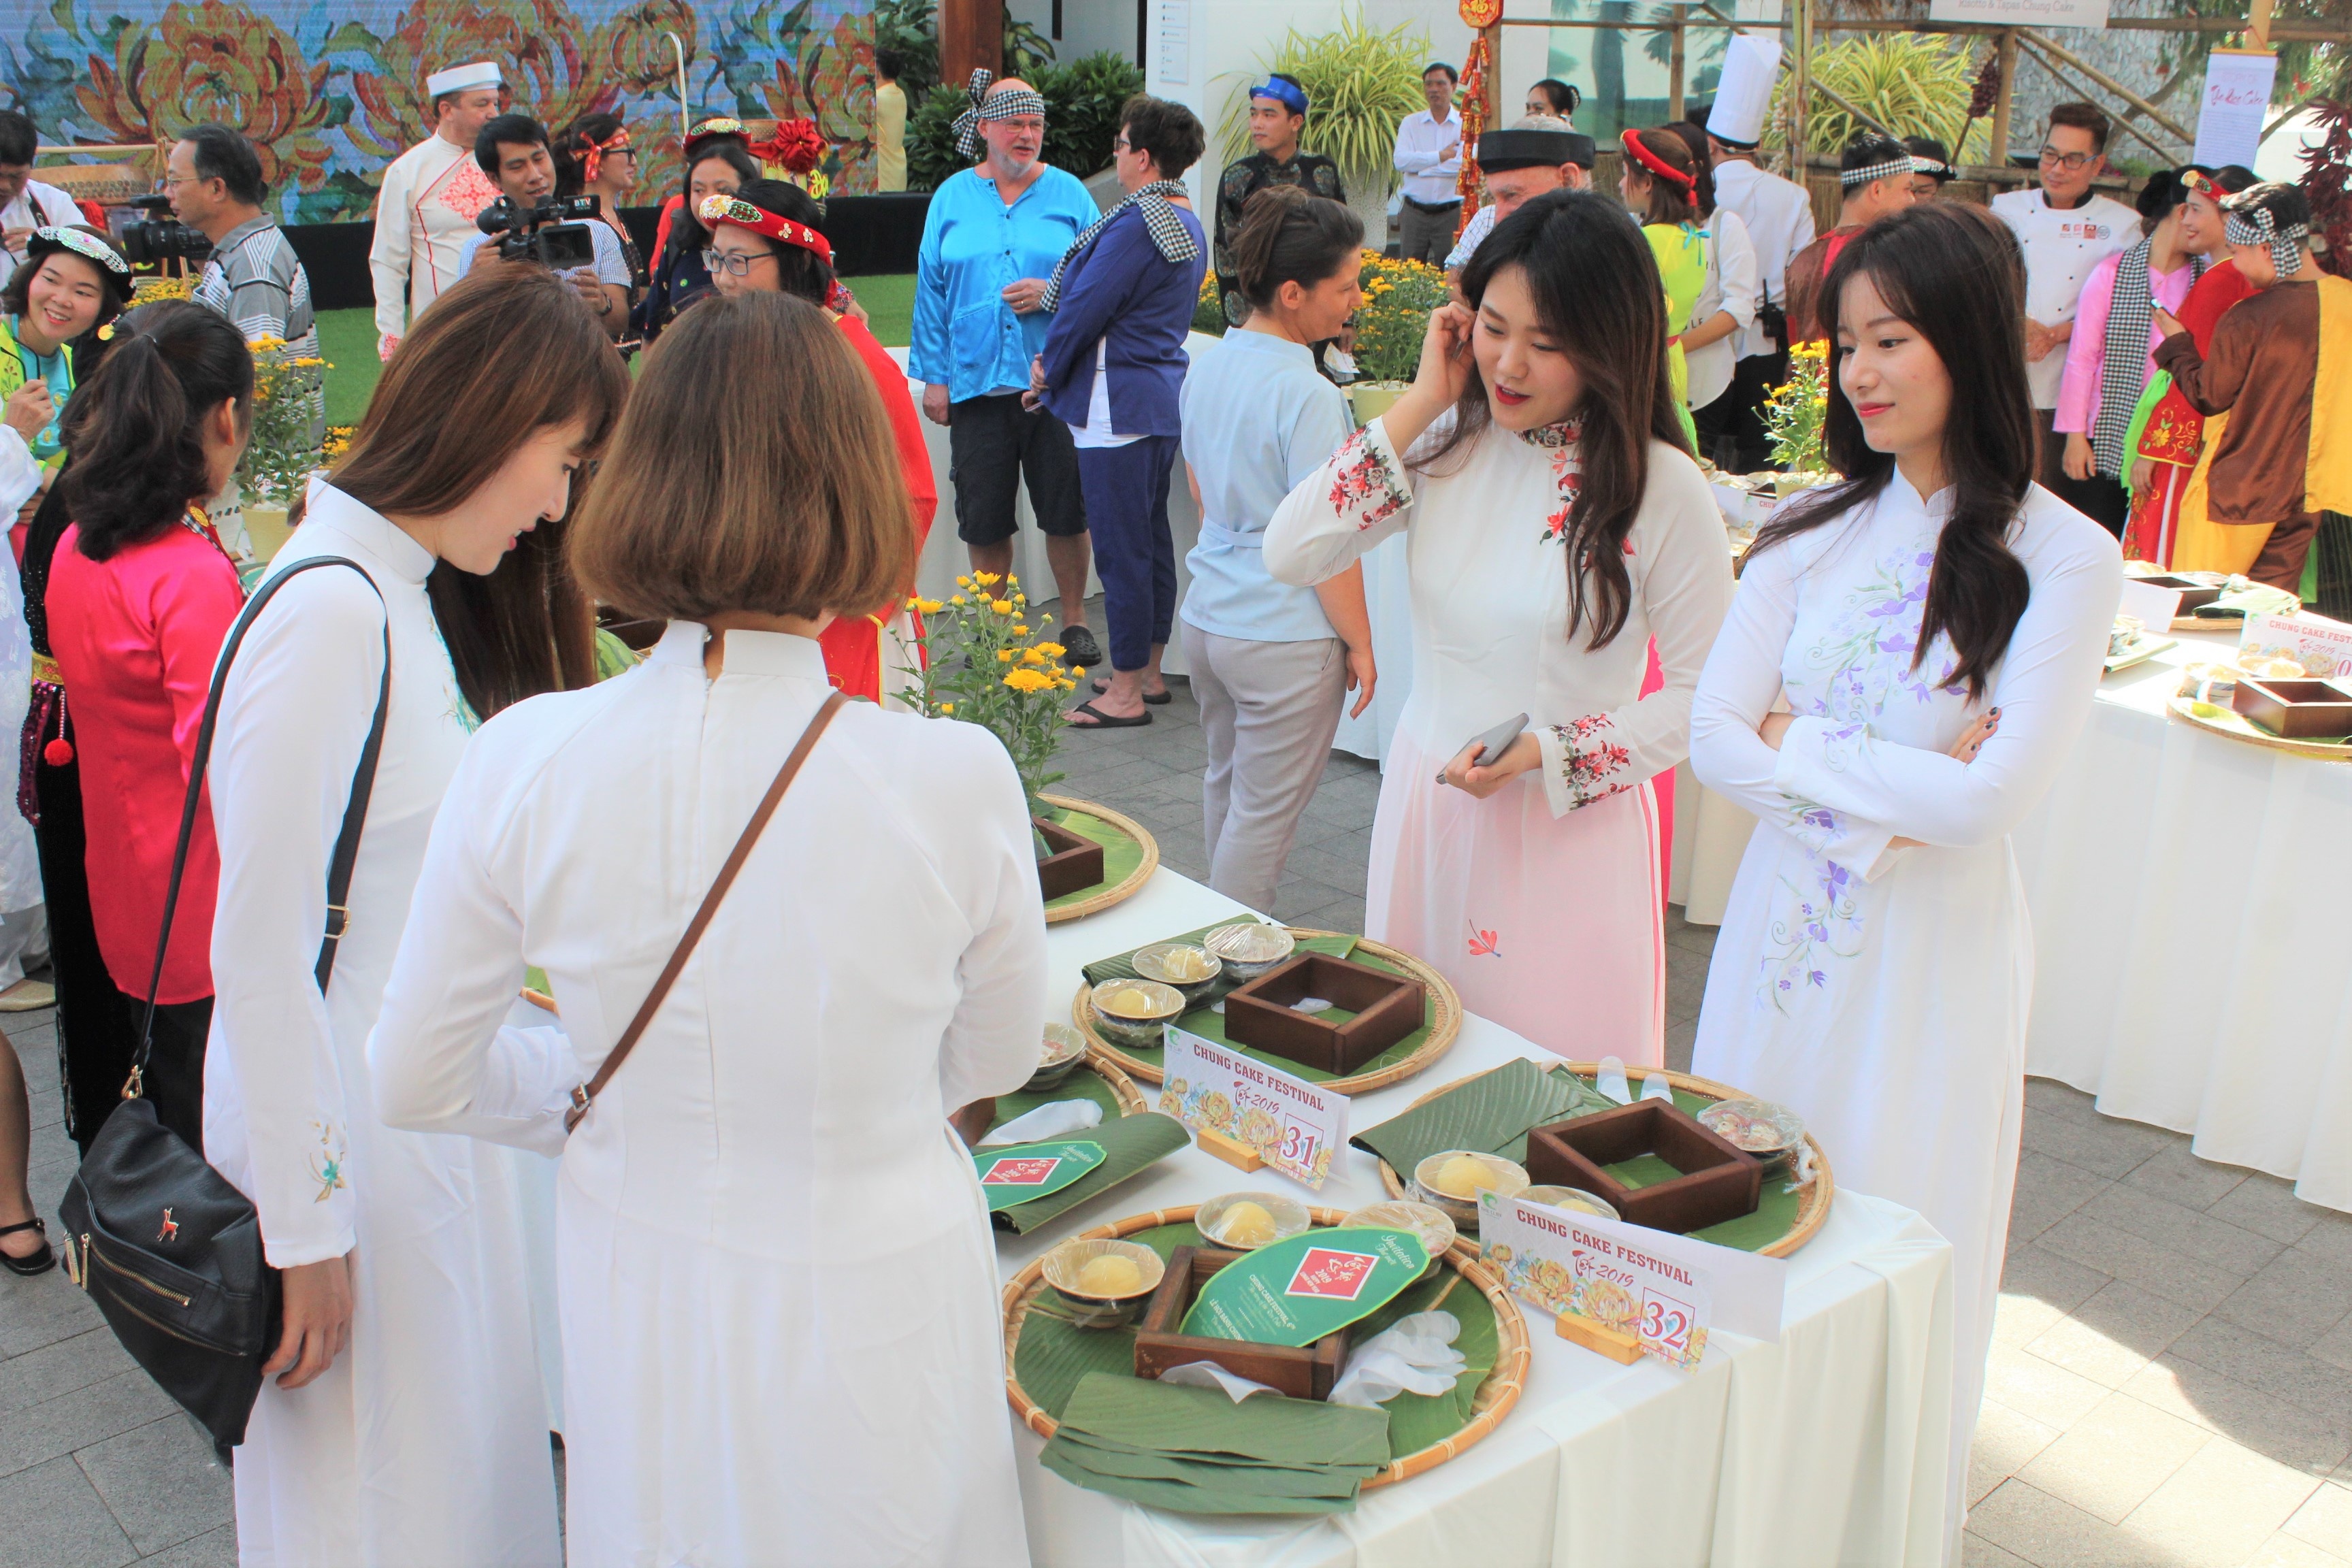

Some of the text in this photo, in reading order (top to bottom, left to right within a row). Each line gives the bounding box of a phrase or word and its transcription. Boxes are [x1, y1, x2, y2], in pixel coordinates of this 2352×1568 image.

[2022, 0, 2051, 14] Chung
[2053, 1, 2074, 12] Cake
[574, 197, 591, 207] BTV
[2269, 620, 2300, 633] CHUNG
[2302, 626, 2325, 638] CAKE
[1194, 1044, 1324, 1111] CHUNG CAKE FESTIVAL
[1250, 1095, 1280, 1115] 2019
[1282, 1126, 1316, 1169] 31
[1382, 1235, 1415, 1269] Invitation
[1517, 1208, 1693, 1287] CHUNG CAKE FESTIVAL
[1249, 1274, 1264, 1292] CHUNG
[1261, 1290, 1274, 1303] CAKE
[1315, 1269, 1332, 1283] 2019
[1596, 1264, 1635, 1288] 2019
[1642, 1301, 1688, 1351] 32
